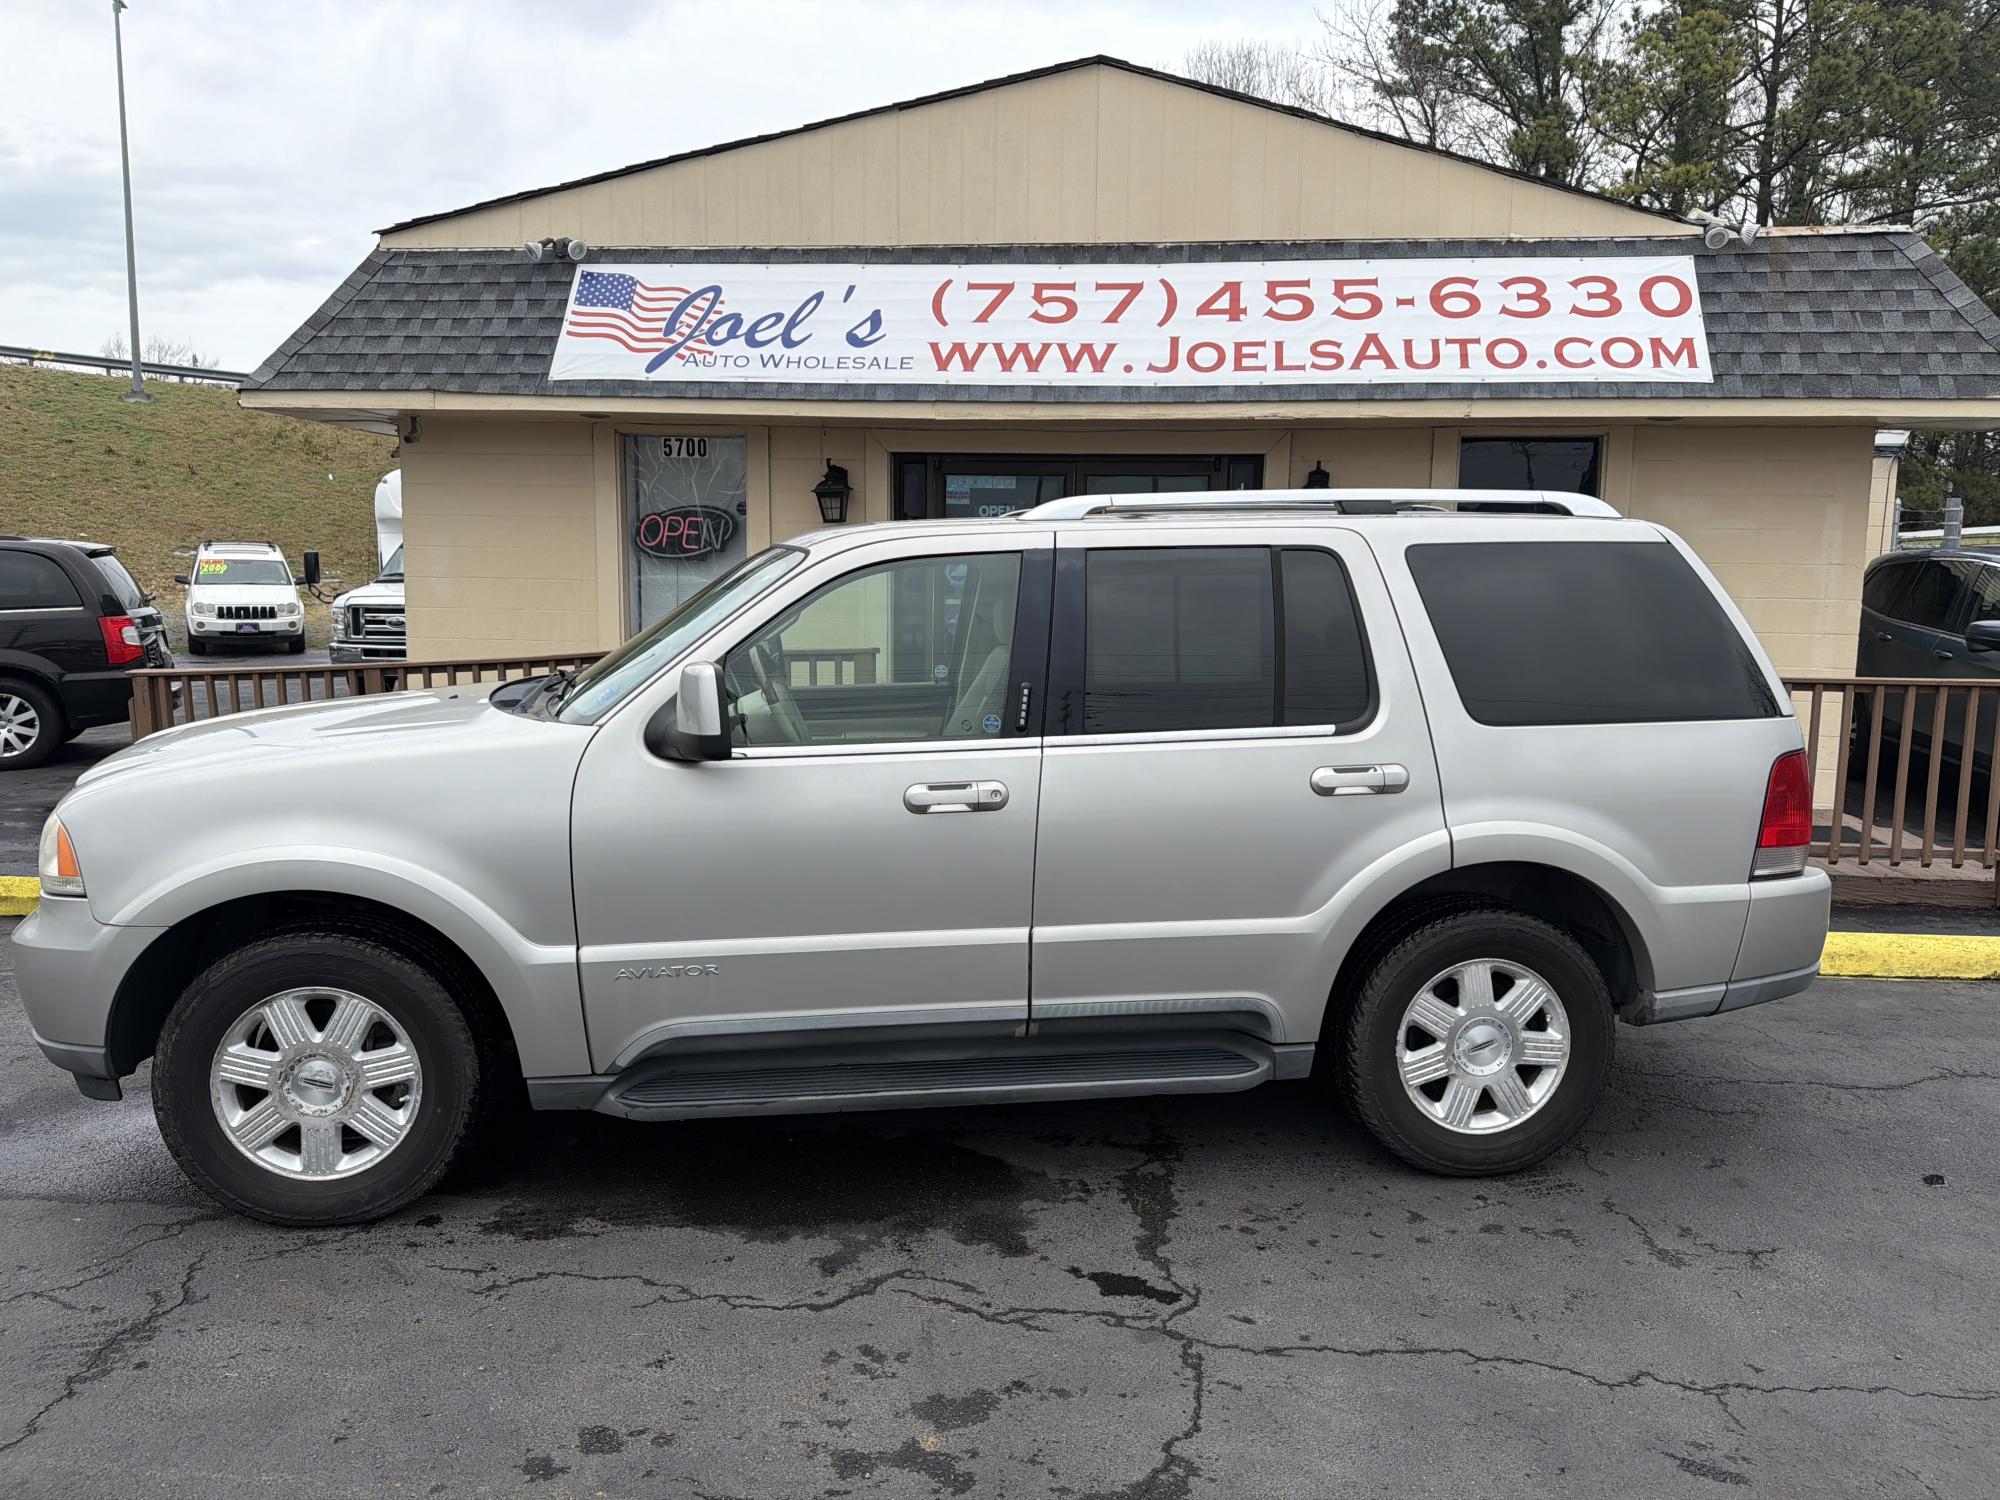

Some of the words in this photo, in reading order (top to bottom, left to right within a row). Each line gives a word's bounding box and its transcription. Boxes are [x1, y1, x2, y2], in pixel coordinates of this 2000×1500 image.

[645, 285, 886, 373] Joel's
[663, 438, 708, 457] 5700
[640, 515, 726, 550] OPEN
[614, 964, 720, 981] AVIATOR
